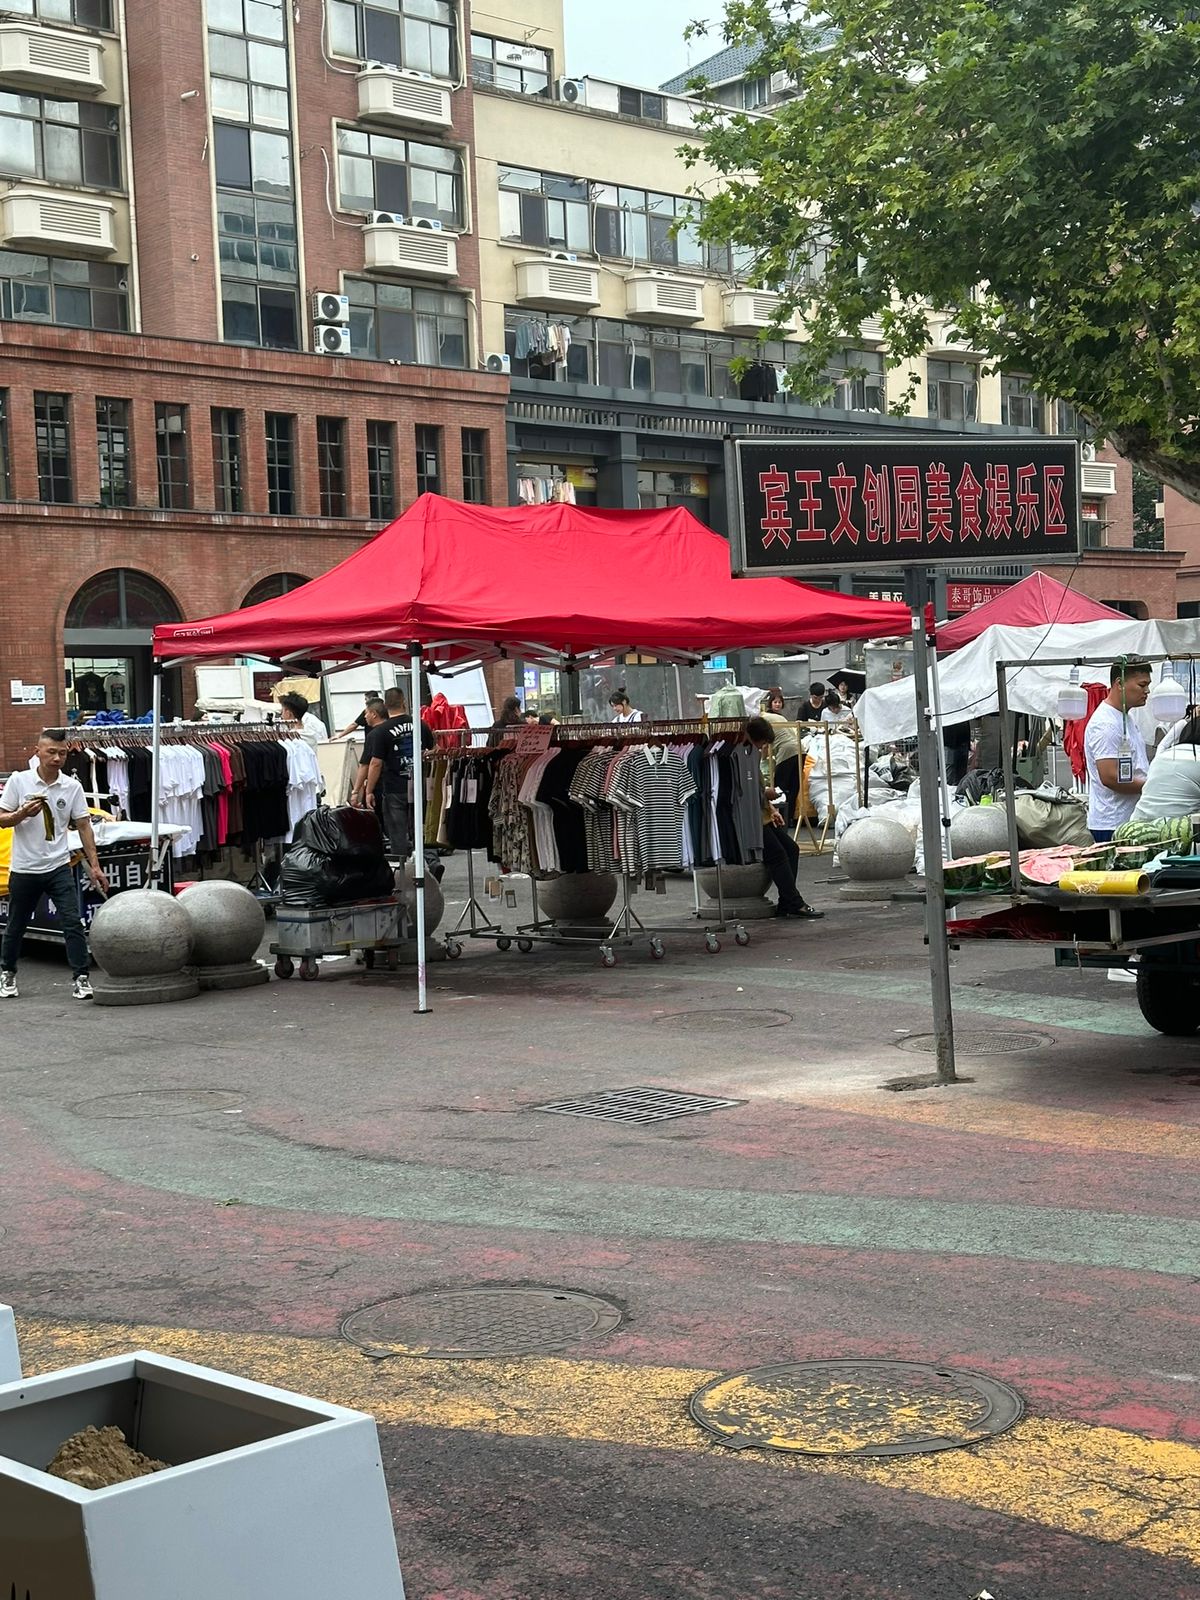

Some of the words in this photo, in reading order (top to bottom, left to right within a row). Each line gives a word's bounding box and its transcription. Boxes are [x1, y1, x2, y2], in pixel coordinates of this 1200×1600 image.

[758, 461, 1067, 549] 宾王文创园美食娱乐区
